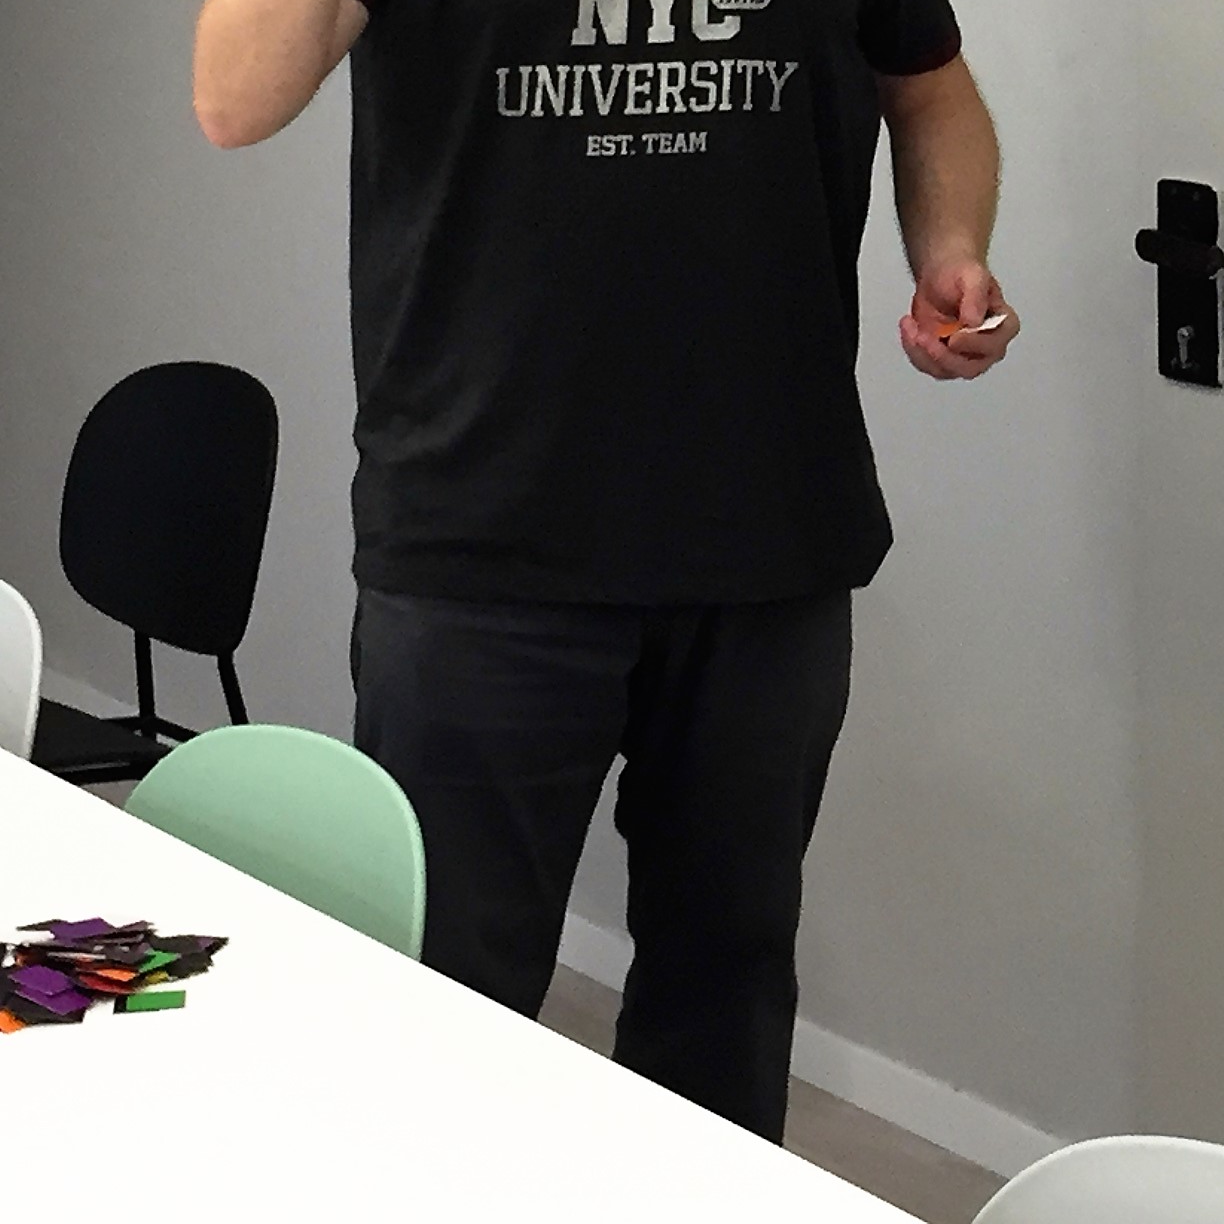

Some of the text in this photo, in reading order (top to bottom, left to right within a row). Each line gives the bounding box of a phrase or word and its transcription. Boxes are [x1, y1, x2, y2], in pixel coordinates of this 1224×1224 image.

[496, 59, 799, 117] UNIVERSITY
[586, 131, 708, 158] EST. TEAM
